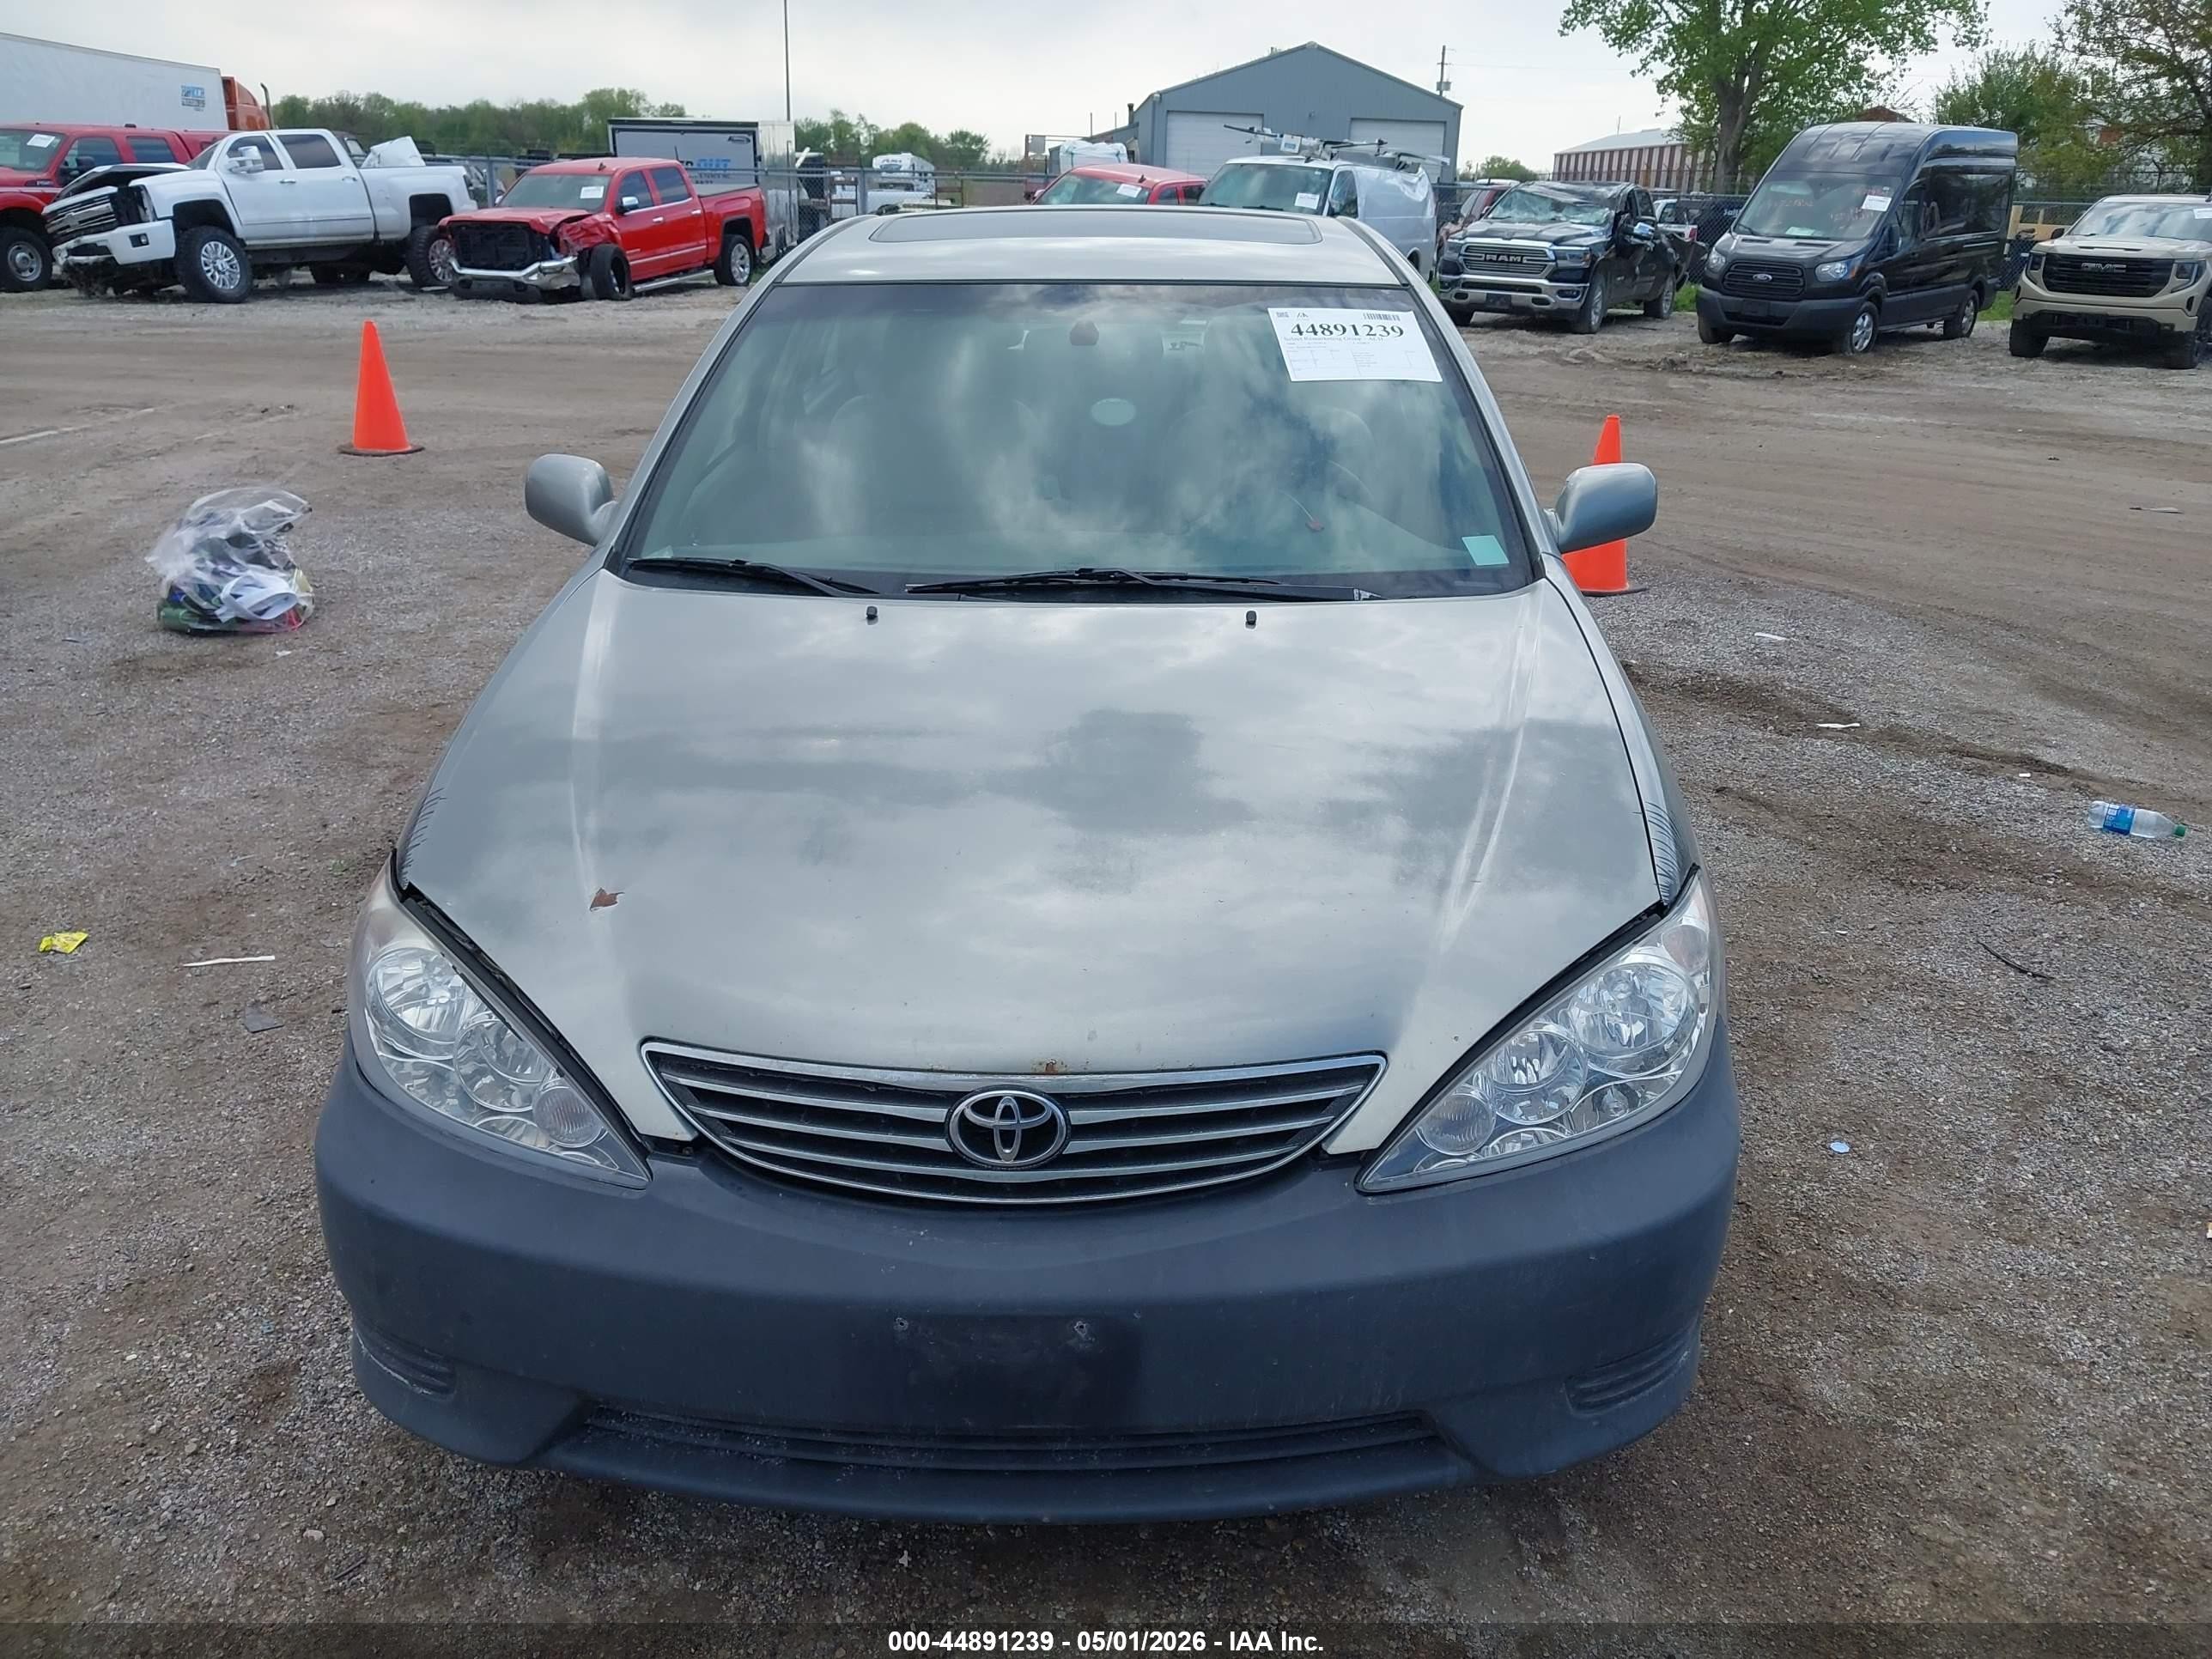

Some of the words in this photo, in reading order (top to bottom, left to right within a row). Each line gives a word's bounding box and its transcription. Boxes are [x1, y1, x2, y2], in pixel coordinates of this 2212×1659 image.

[1486, 253, 1522, 263] RAM
[2081, 262, 2127, 273] GMC
[1291, 323, 1404, 337] 44891239
